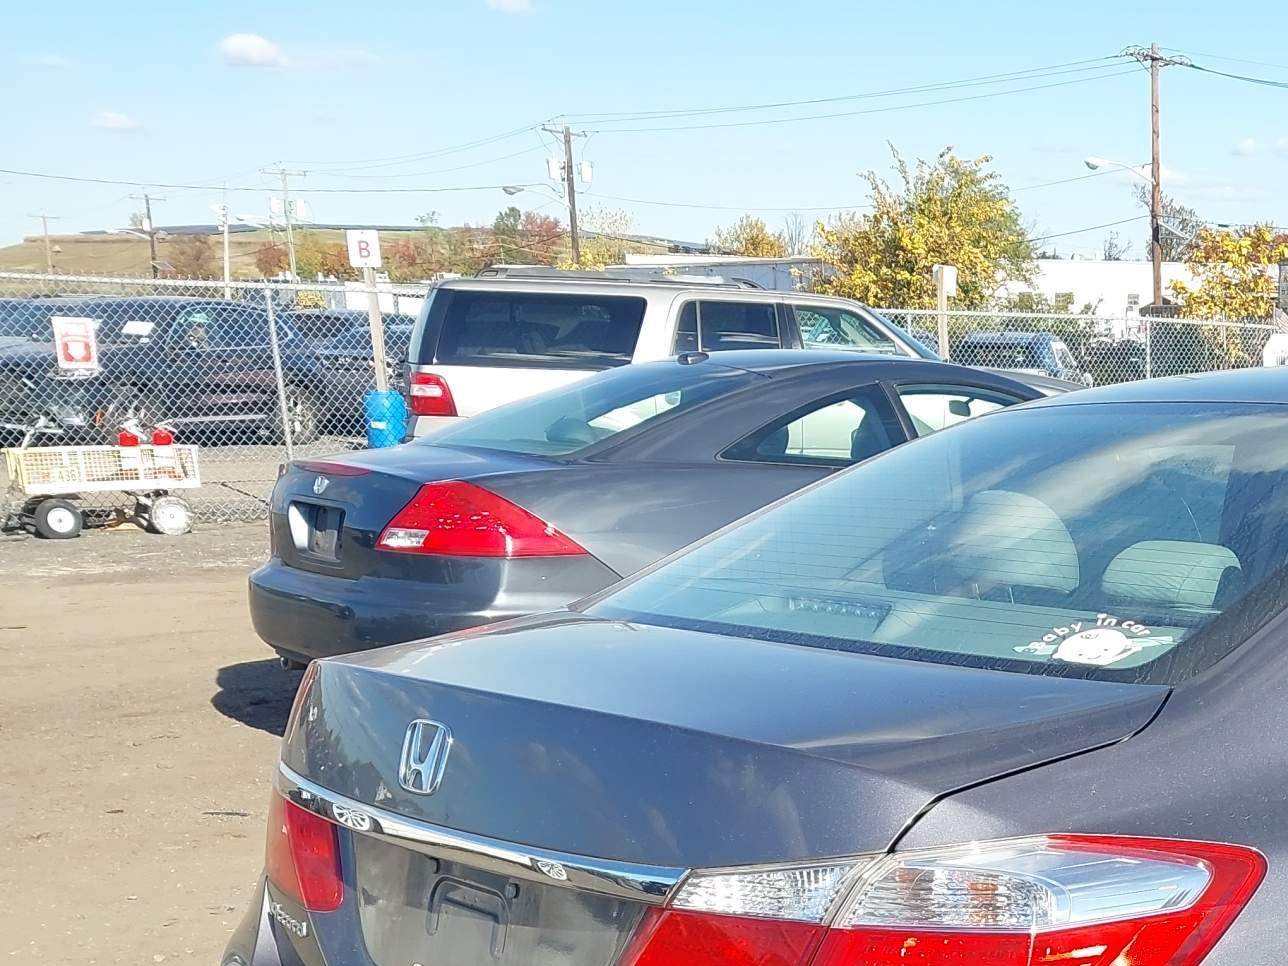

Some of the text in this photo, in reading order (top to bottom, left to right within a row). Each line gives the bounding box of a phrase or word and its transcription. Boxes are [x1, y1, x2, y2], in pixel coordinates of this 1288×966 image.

[358, 240, 371, 259] B
[1024, 621, 1083, 654] Baby
[1121, 620, 1152, 636] car
